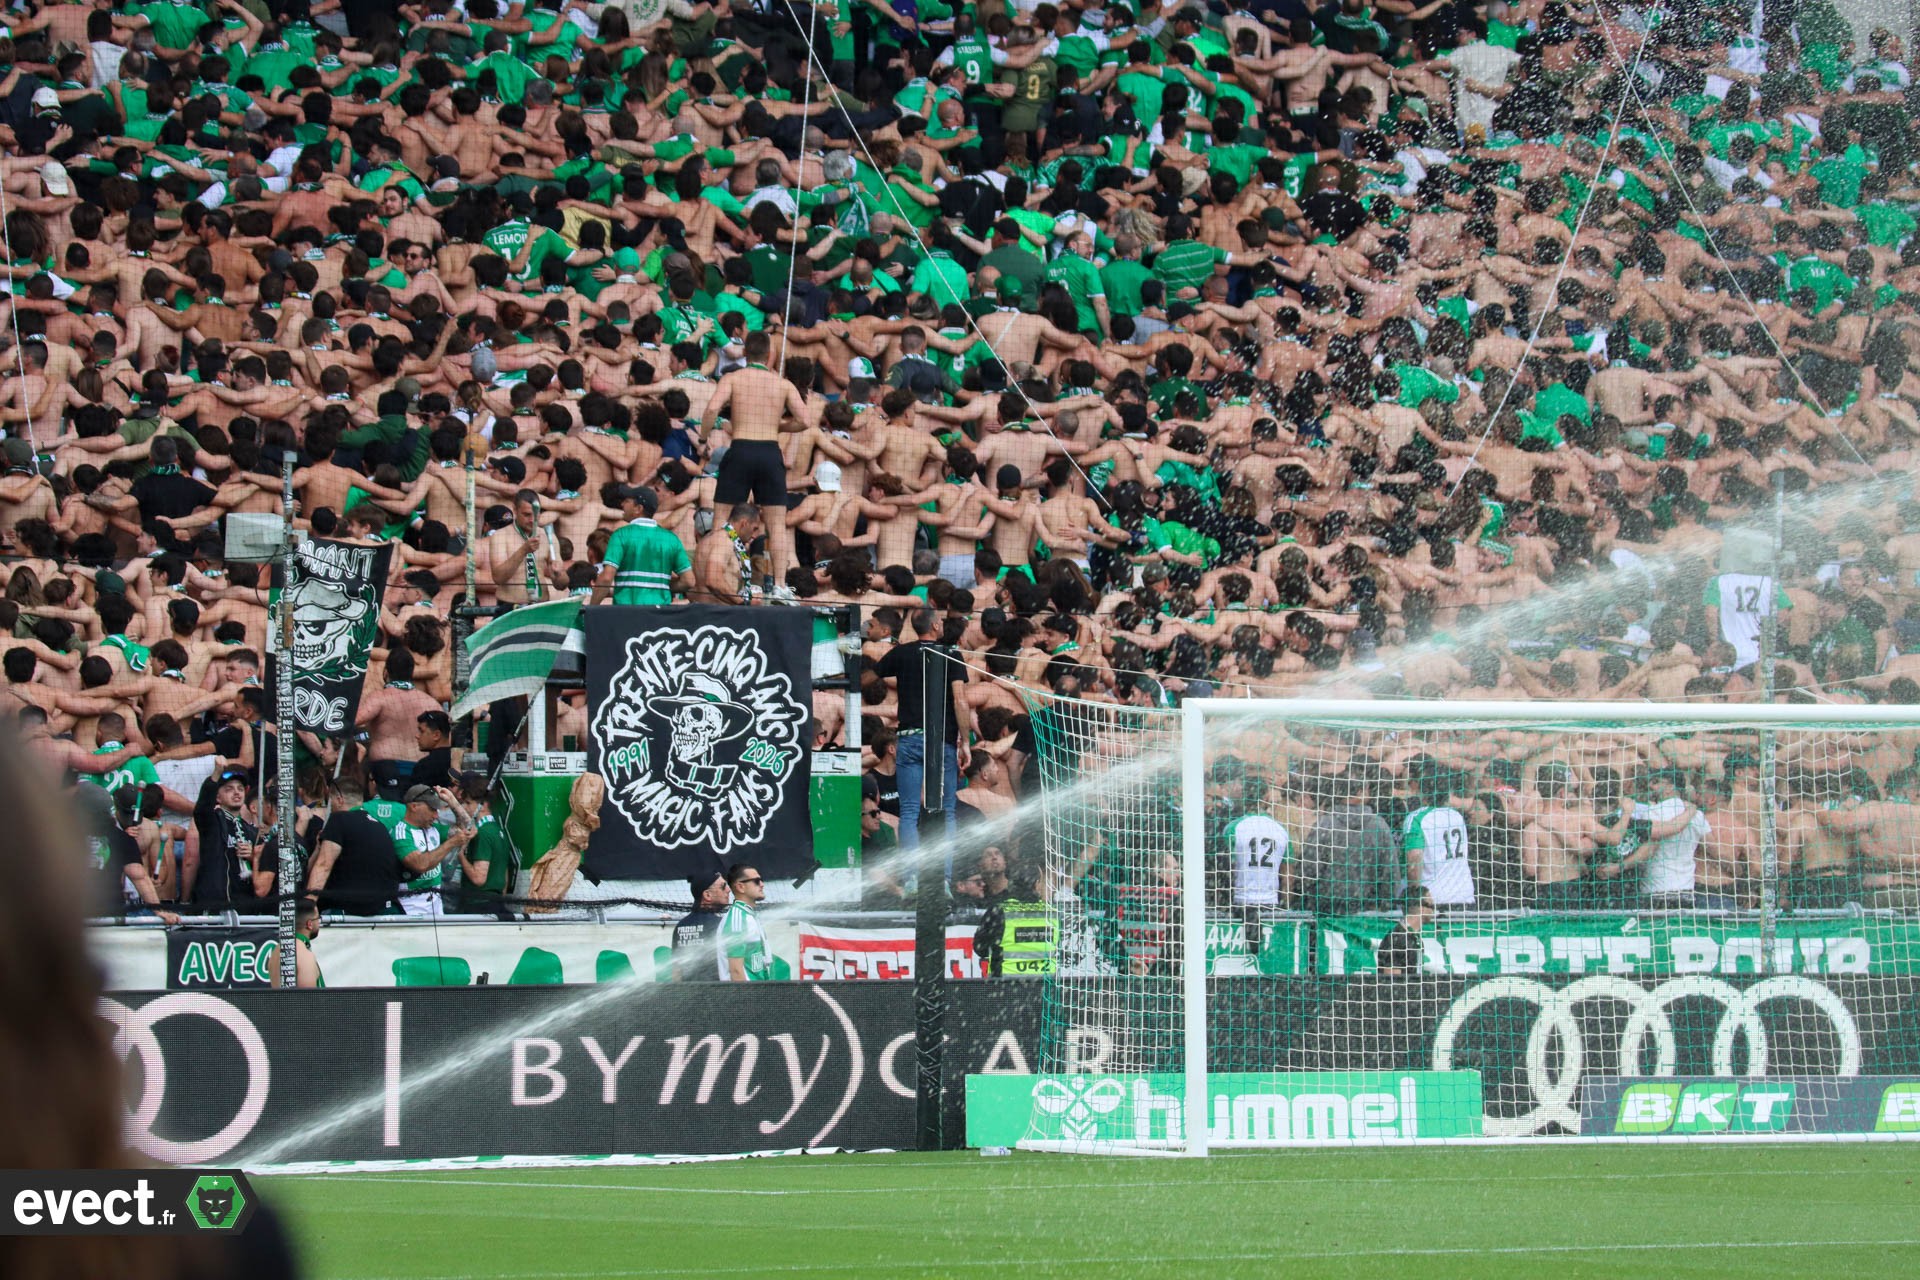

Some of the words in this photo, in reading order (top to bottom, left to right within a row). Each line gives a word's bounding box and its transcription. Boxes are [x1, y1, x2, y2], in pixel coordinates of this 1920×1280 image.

[966, 60, 980, 84] 9
[1026, 74, 1040, 99] 9
[1735, 587, 1759, 612] 12
[293, 686, 349, 731] RDE
[741, 684, 796, 739] ANS
[608, 736, 650, 784] 1991
[739, 738, 792, 776] 2026
[619, 768, 704, 838] MAGIC
[710, 767, 773, 842] FANS
[1248, 837, 1275, 867] 12
[1443, 828, 1464, 859] 12
[1206, 925, 1273, 951] AVAT
[1621, 1092, 1790, 1123] BKT
